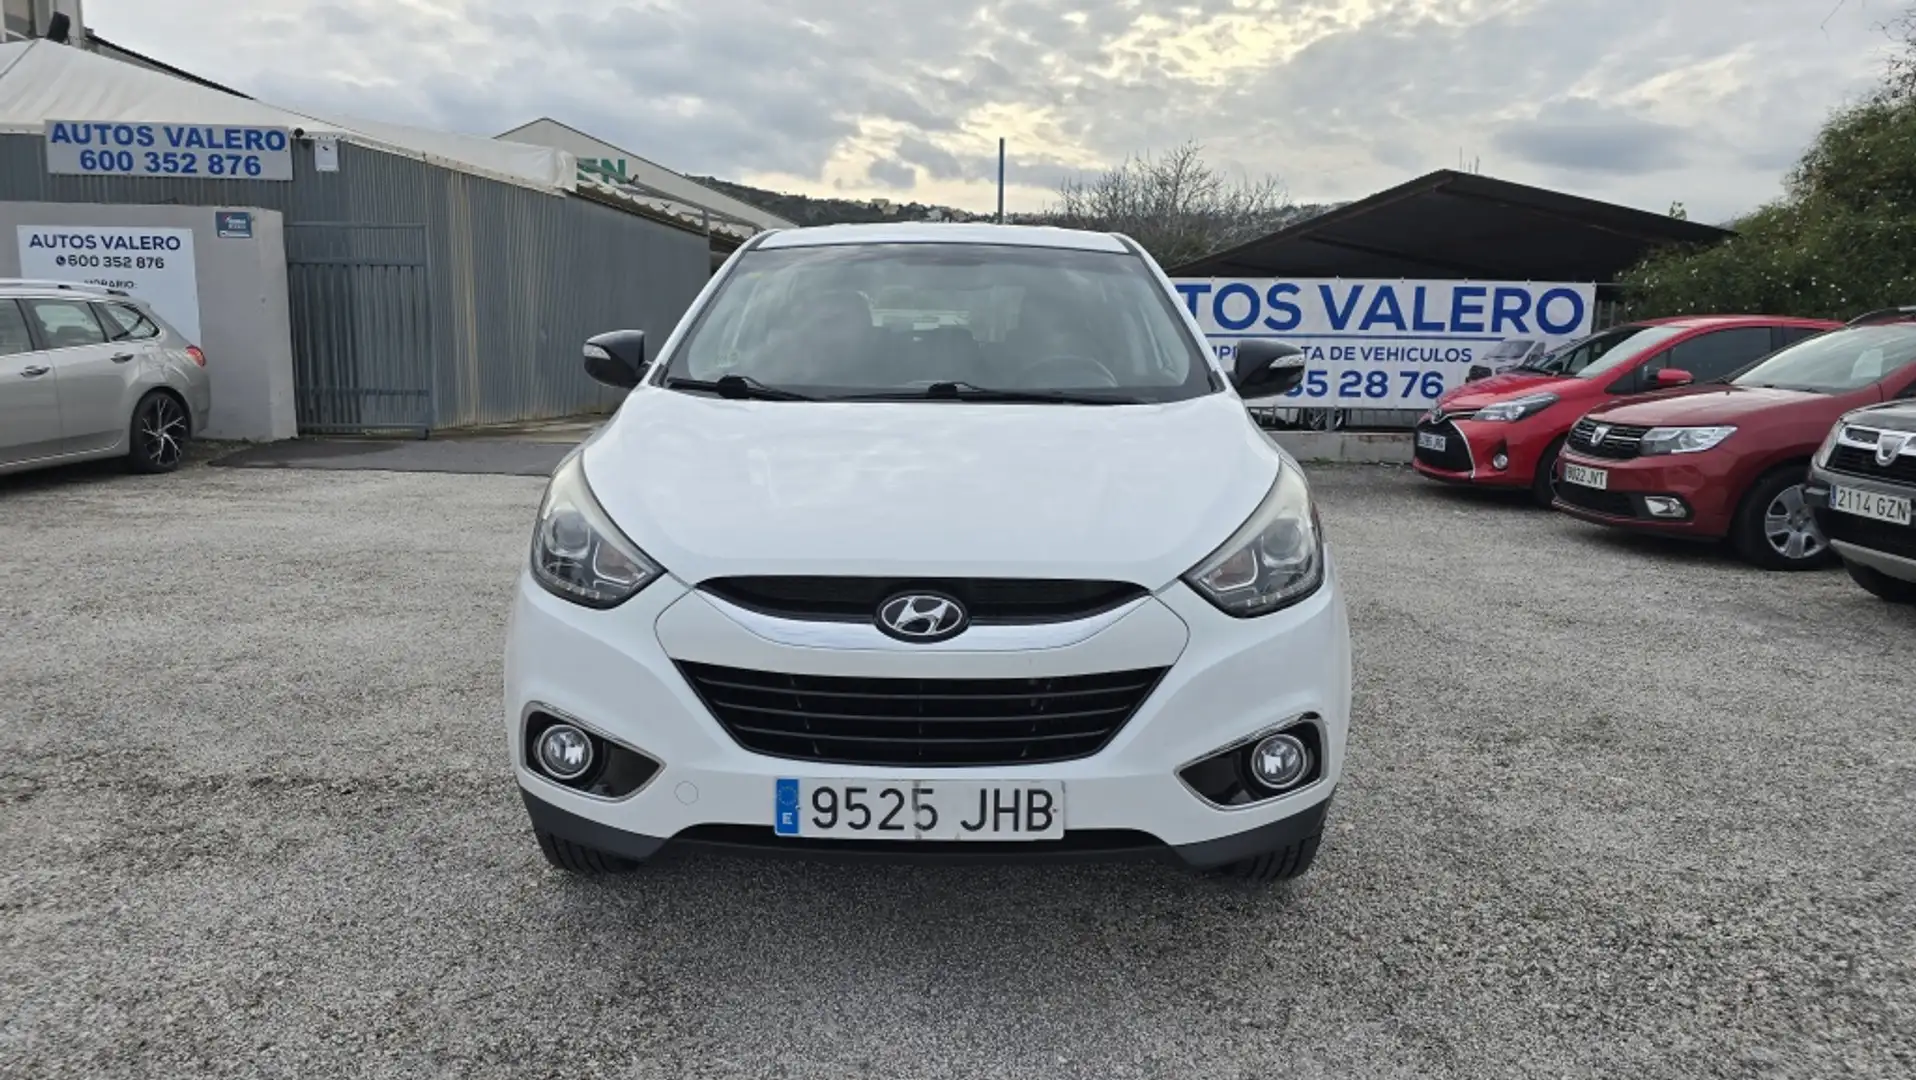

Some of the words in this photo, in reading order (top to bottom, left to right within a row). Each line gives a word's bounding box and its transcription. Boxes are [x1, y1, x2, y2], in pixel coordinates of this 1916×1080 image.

[50, 122, 154, 147] AUTOS
[163, 126, 286, 151] VALERO
[80, 149, 133, 171] 600
[144, 151, 198, 174] 352
[207, 153, 261, 176] 876
[29, 233, 97, 249] AUTOS
[101, 235, 181, 251] VALERO
[67, 254, 99, 267] 600
[103, 256, 132, 269] 352
[136, 256, 164, 269] 876
[1318, 283, 1585, 335] VALERO
[1330, 346, 1356, 361] DE
[1360, 346, 1472, 363] VEHICULOS
[1338, 370, 1389, 398] 28
[1399, 371, 1444, 399] 76
[1838, 489, 1871, 514] 2114
[1876, 497, 1908, 521] GZN
[782, 812, 793, 825] E
[811, 786, 938, 831] 9525
[960, 788, 1053, 832] JHB
